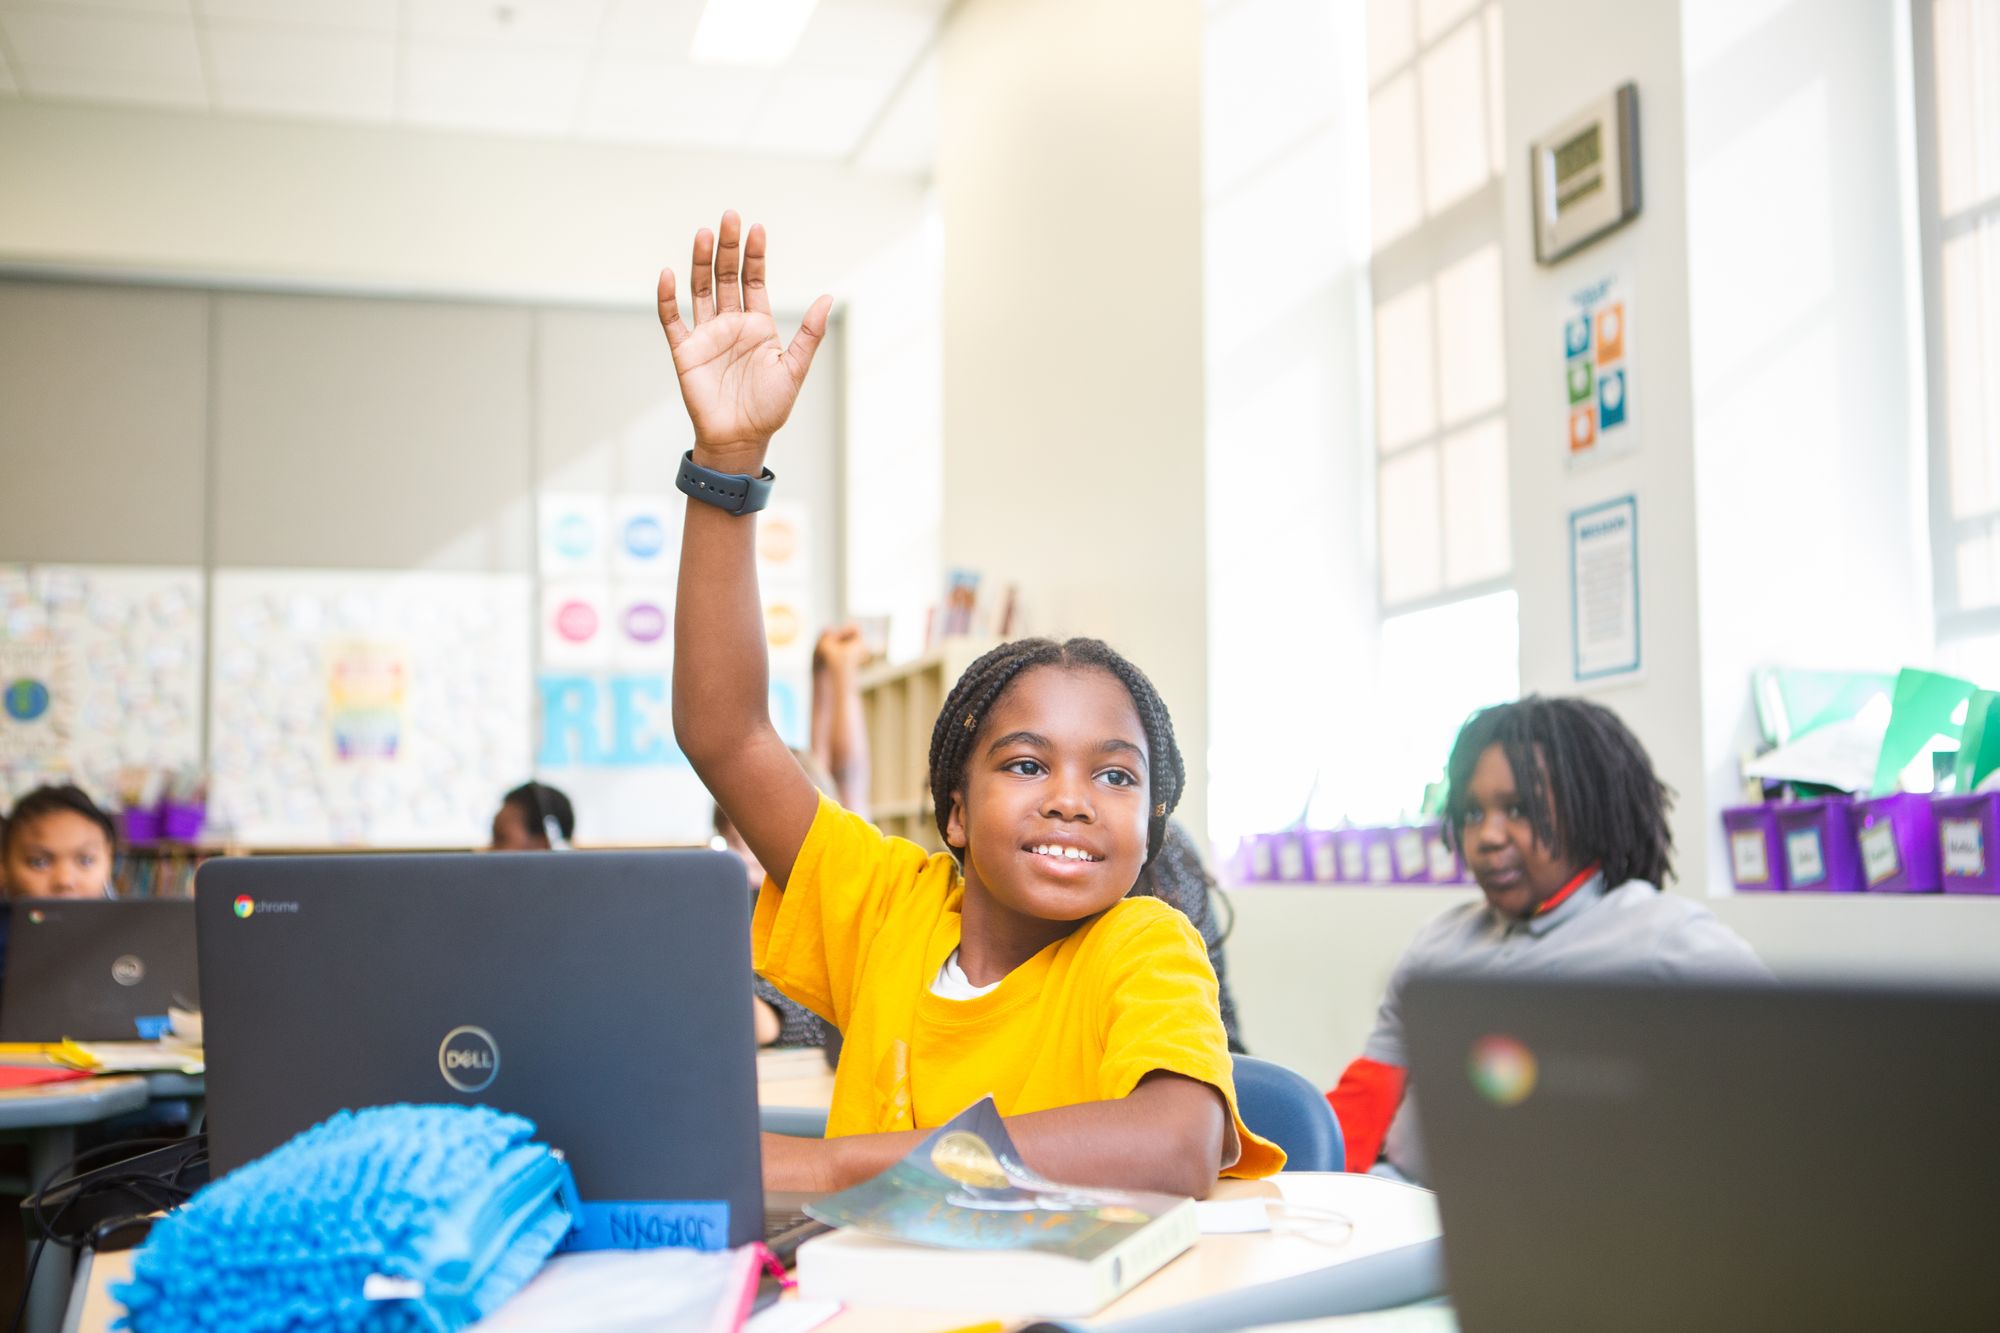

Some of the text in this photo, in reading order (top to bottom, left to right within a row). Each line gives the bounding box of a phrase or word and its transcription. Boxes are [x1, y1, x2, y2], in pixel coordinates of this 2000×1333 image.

[255, 899, 299, 913] chrome
[446, 1049, 492, 1069] DELL
[609, 1212, 714, 1249] JORDYN
